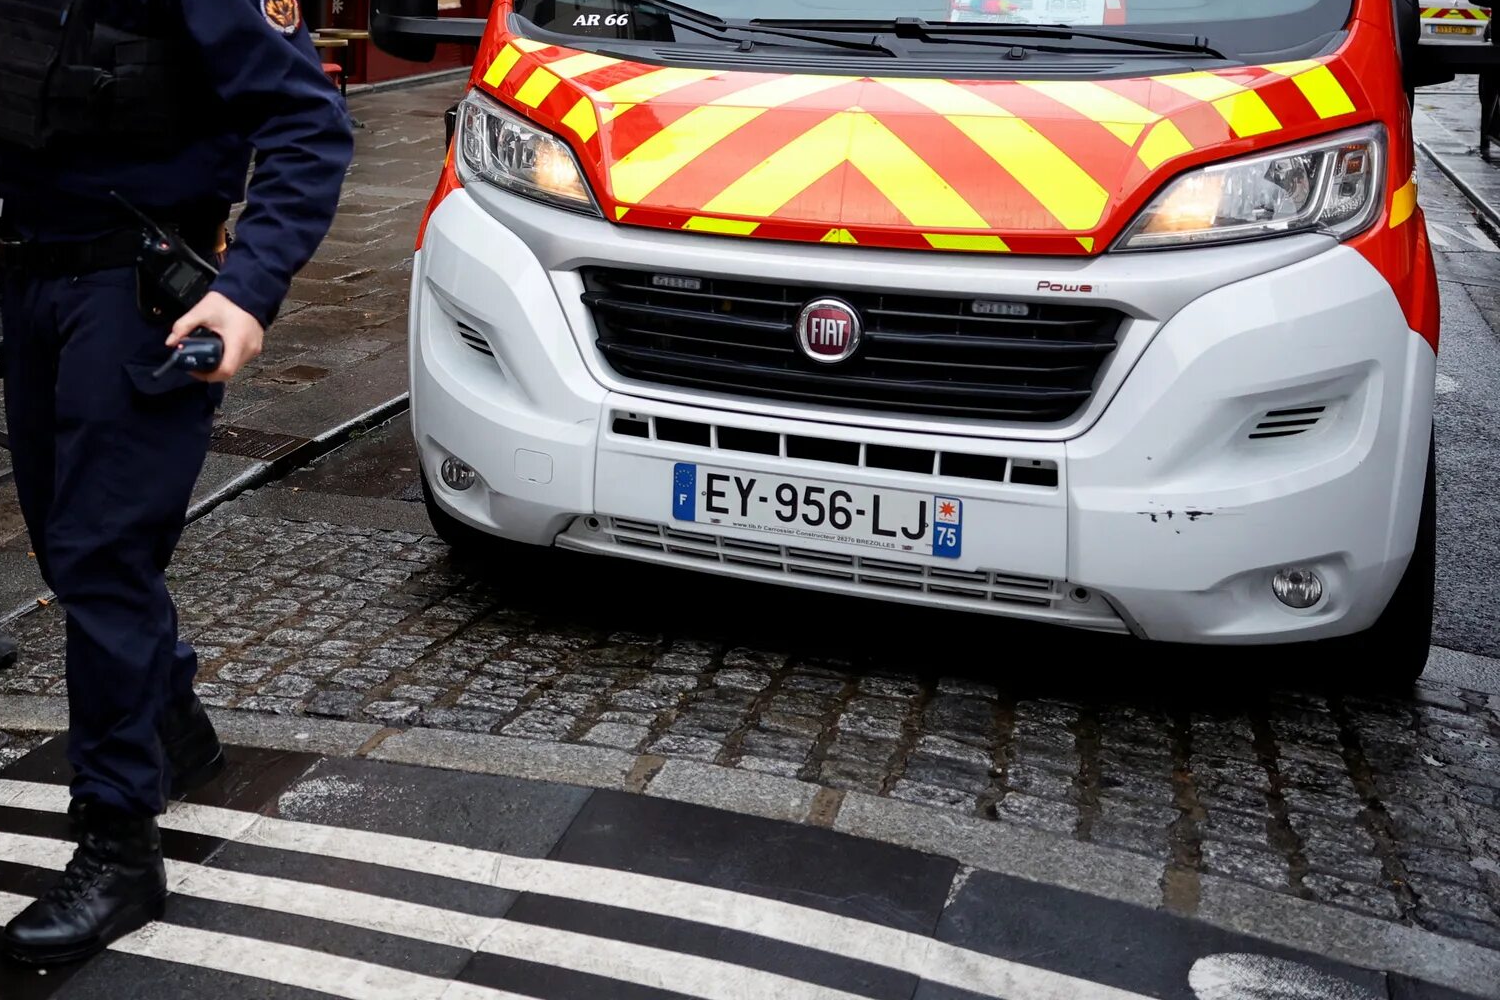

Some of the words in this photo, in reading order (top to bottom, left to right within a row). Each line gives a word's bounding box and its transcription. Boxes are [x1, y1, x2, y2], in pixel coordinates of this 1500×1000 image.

[572, 14, 601, 27] AR
[604, 13, 629, 27] 66
[810, 317, 848, 348] FIAT
[679, 494, 688, 506] F
[705, 472, 927, 541] EY-956-LJ
[763, 525, 796, 535] Carrossier
[795, 529, 836, 541] Constructeur
[855, 538, 896, 549] BREZOLLES
[937, 526, 957, 548] 75
